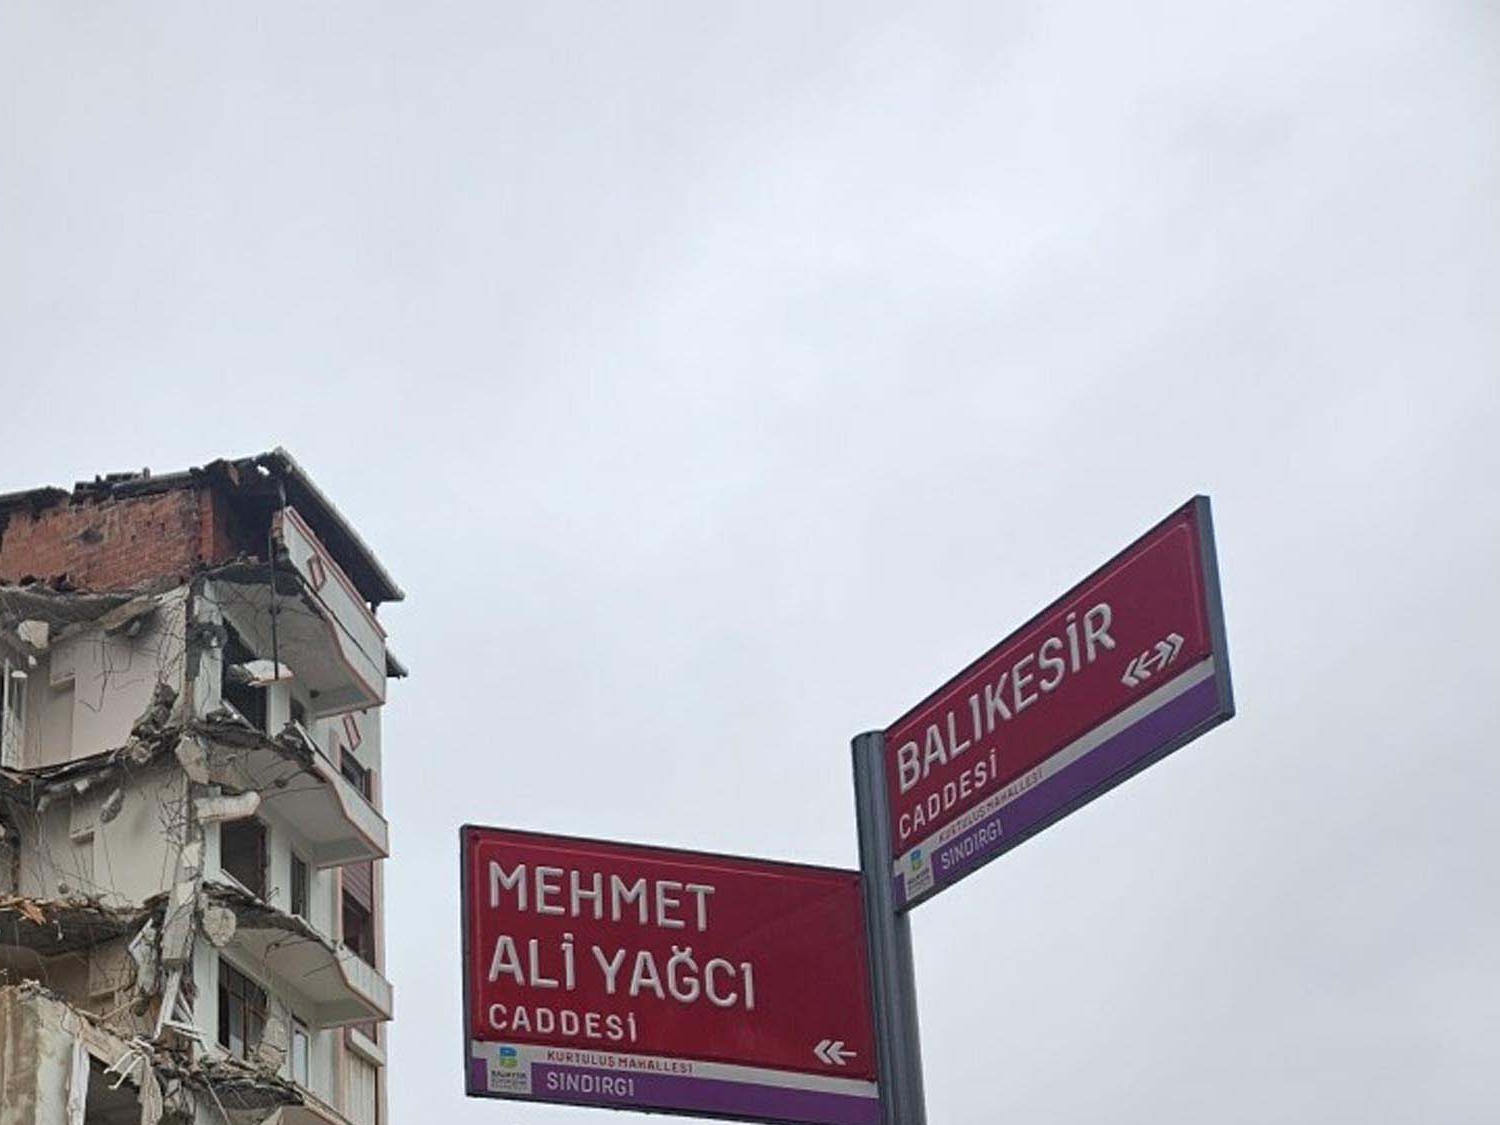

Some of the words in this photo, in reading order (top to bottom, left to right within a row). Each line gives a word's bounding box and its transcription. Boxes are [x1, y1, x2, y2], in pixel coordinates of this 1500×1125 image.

[897, 602, 1117, 794] BALIKESİR
[899, 749, 998, 840] CADDESİ
[941, 818, 1003, 870] SINDIRGI
[489, 861, 716, 932] MEHMET
[488, 933, 575, 991] ALİ
[591, 945, 755, 1009] YAĞCI
[489, 1003, 637, 1042] CADDESİ
[546, 1071, 635, 1097] SINDIRGI
